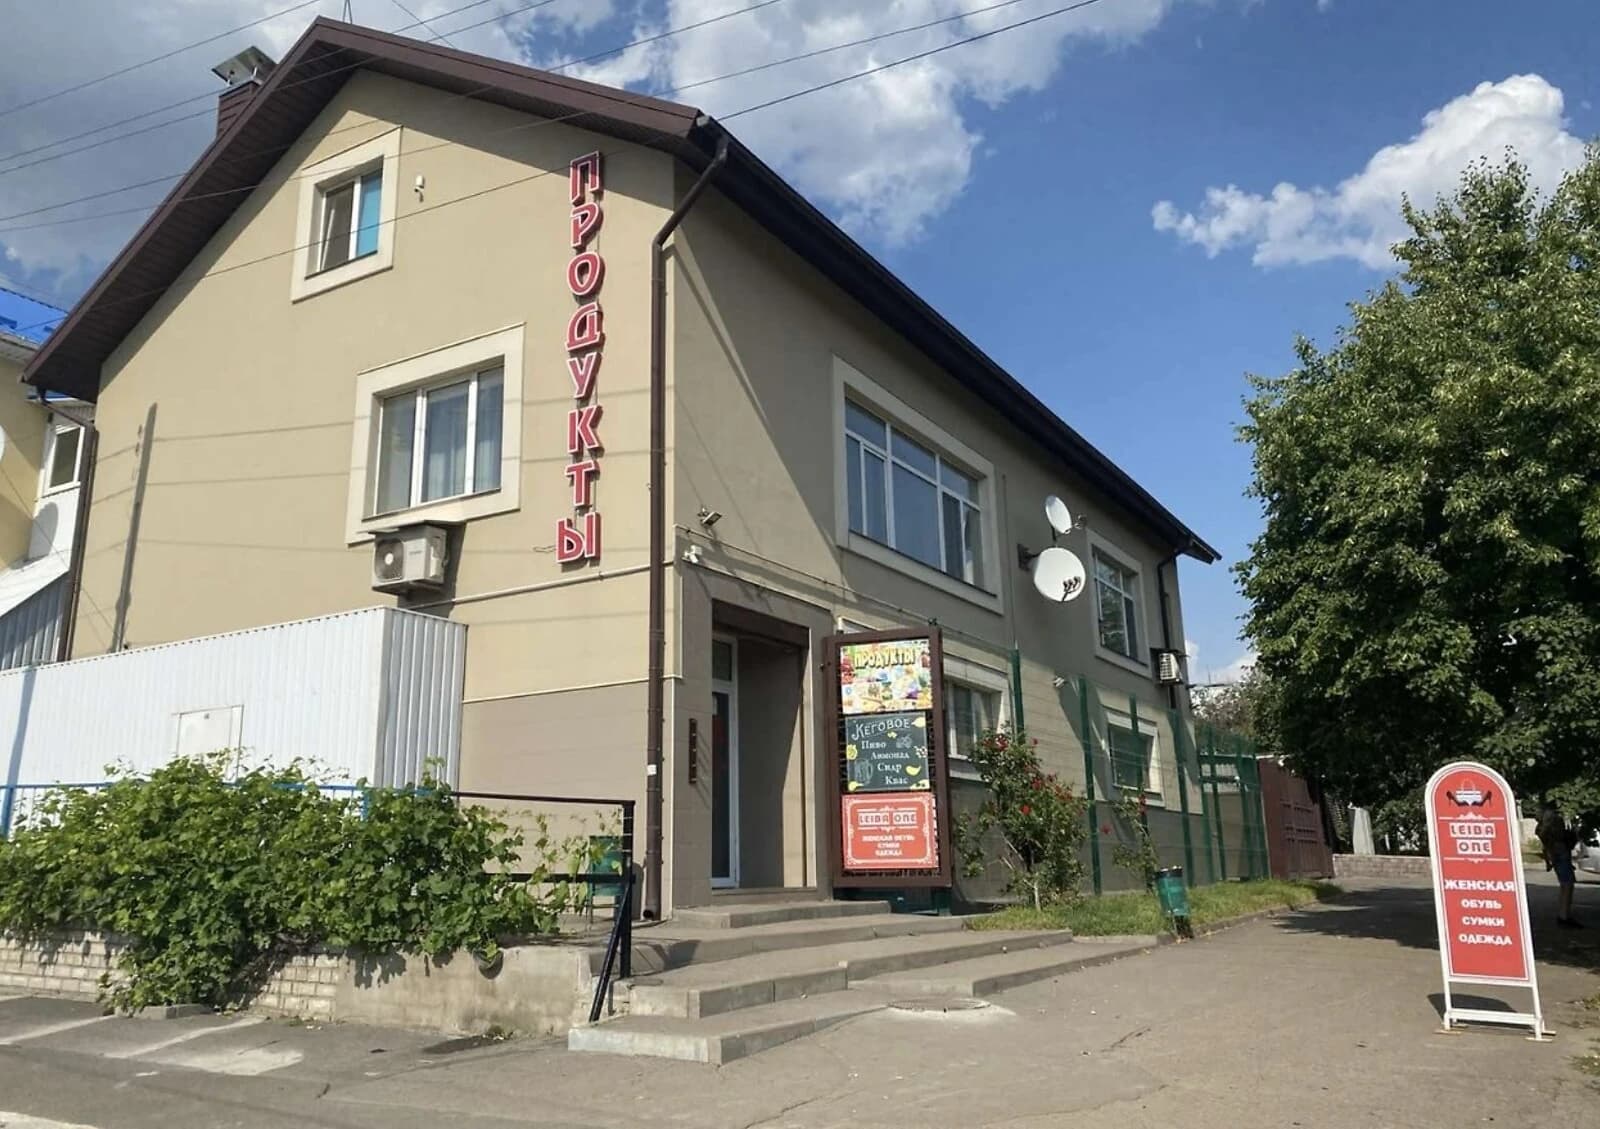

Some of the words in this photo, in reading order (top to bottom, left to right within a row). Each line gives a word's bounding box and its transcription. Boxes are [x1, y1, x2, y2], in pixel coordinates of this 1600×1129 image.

[556, 151, 603, 565] ПРОДУКТЫ
[854, 648, 916, 669] ПРОДУКТЫ
[851, 718, 911, 740] КЕГОВОЕ
[861, 740, 887, 750] Пиво
[877, 762, 902, 773] Сидр
[885, 775, 908, 785] Квас
[859, 813, 889, 825] LEIBA
[893, 812, 916, 824] ONE
[1450, 824, 1494, 837] LEIBA
[1458, 841, 1491, 853] ONE
[1444, 880, 1515, 892] ЖЕНСКАЯ
[1461, 899, 1502, 909] ОБУВЬ
[1462, 916, 1505, 927] СУМКИ
[1459, 934, 1512, 946] ОДЕЖДА
